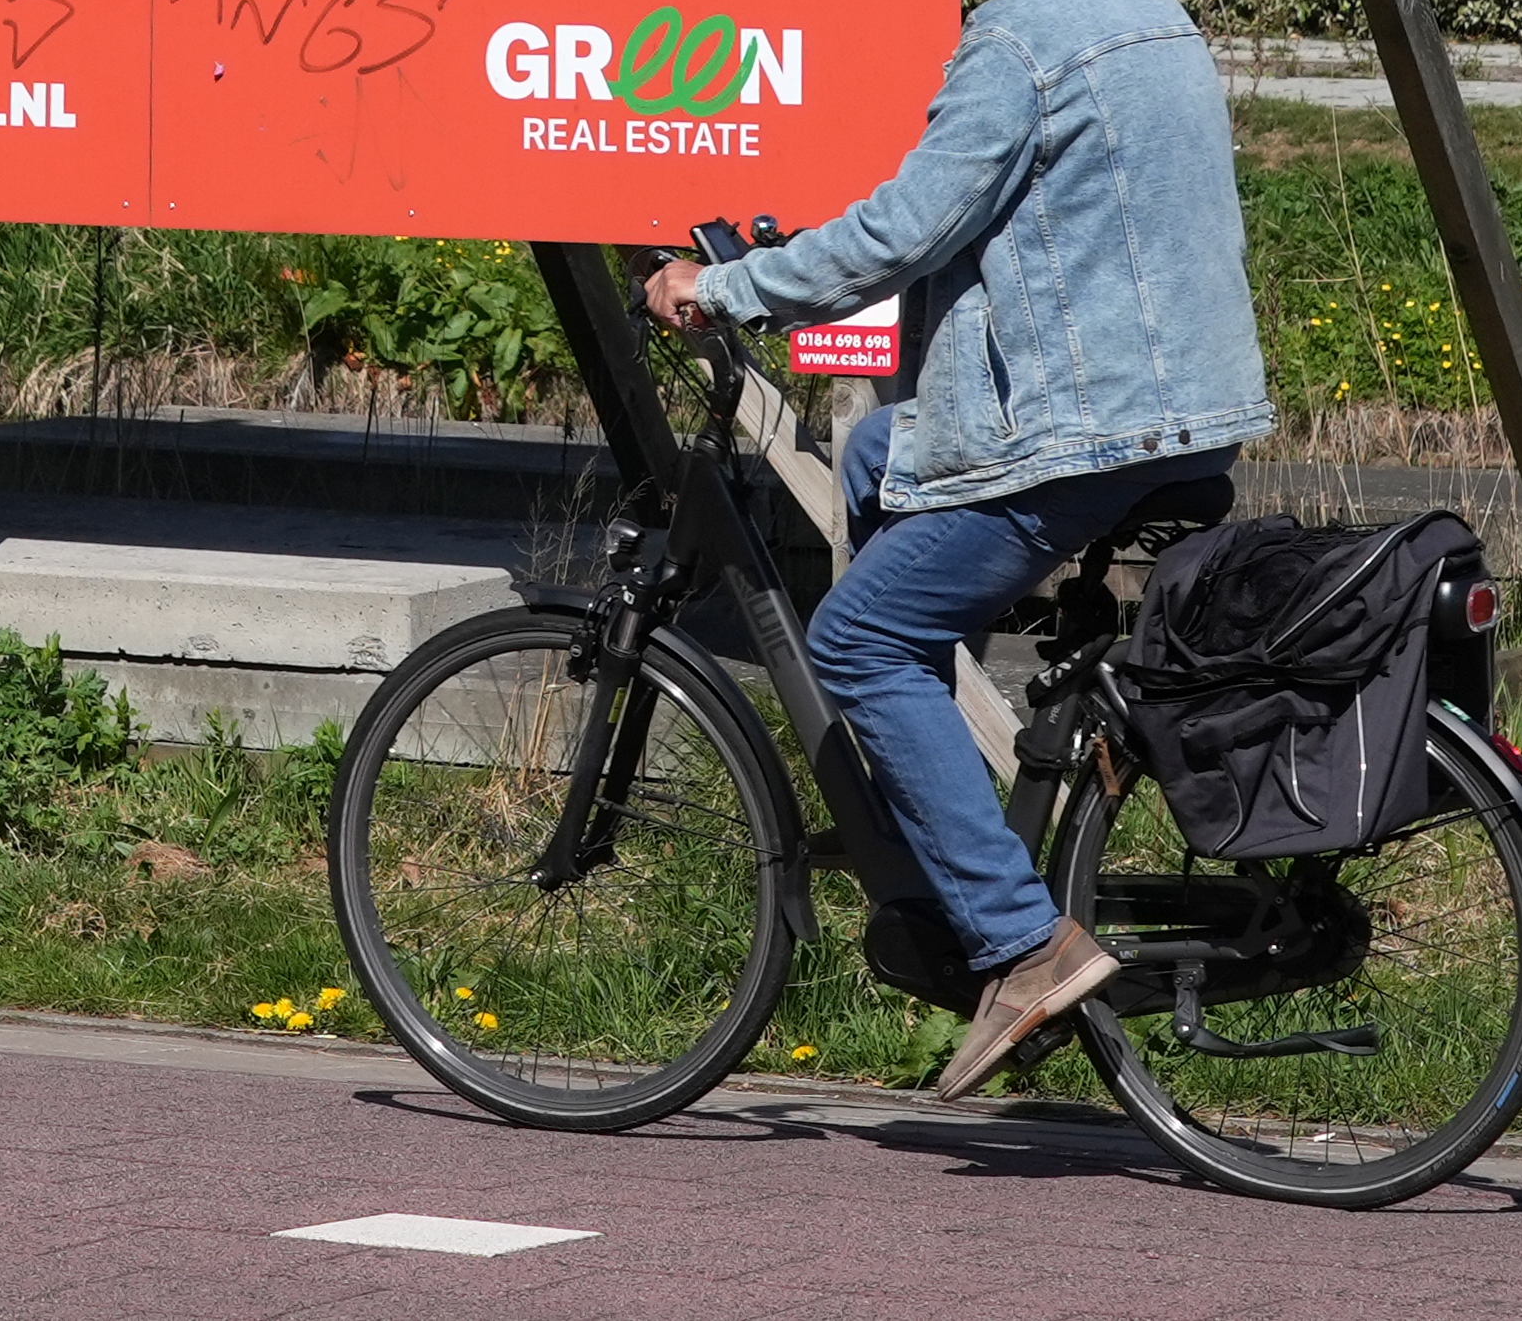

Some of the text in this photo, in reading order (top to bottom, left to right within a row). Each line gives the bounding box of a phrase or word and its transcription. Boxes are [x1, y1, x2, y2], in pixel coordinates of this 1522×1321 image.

[523, 117, 760, 156] REAL ESTATE
[797, 332, 891, 349] 0184 698 698
